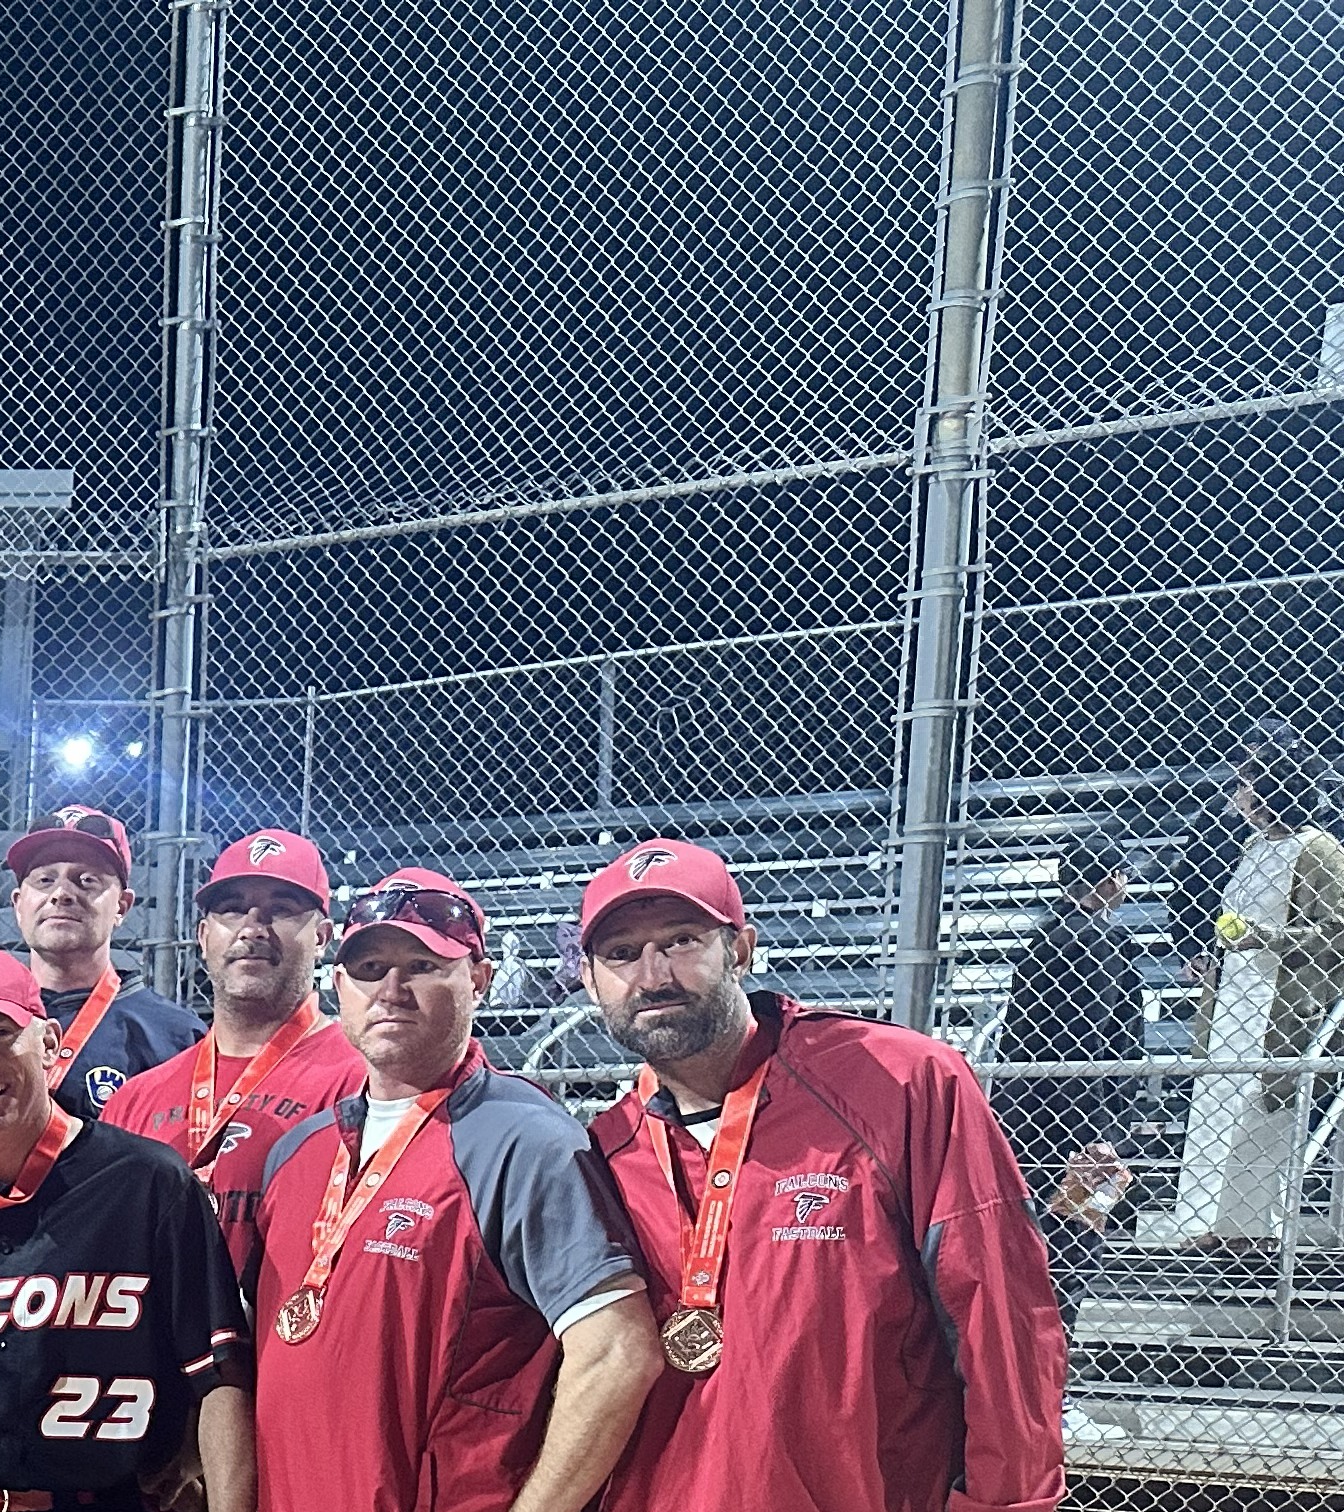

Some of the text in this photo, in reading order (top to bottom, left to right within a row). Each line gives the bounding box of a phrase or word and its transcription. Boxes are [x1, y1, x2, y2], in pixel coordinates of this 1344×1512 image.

[274, 1098, 307, 1120] OF
[774, 1173, 850, 1196] FALCONS
[772, 1226, 846, 1241] FASTBALL
[38, 1374, 156, 1441] 23
